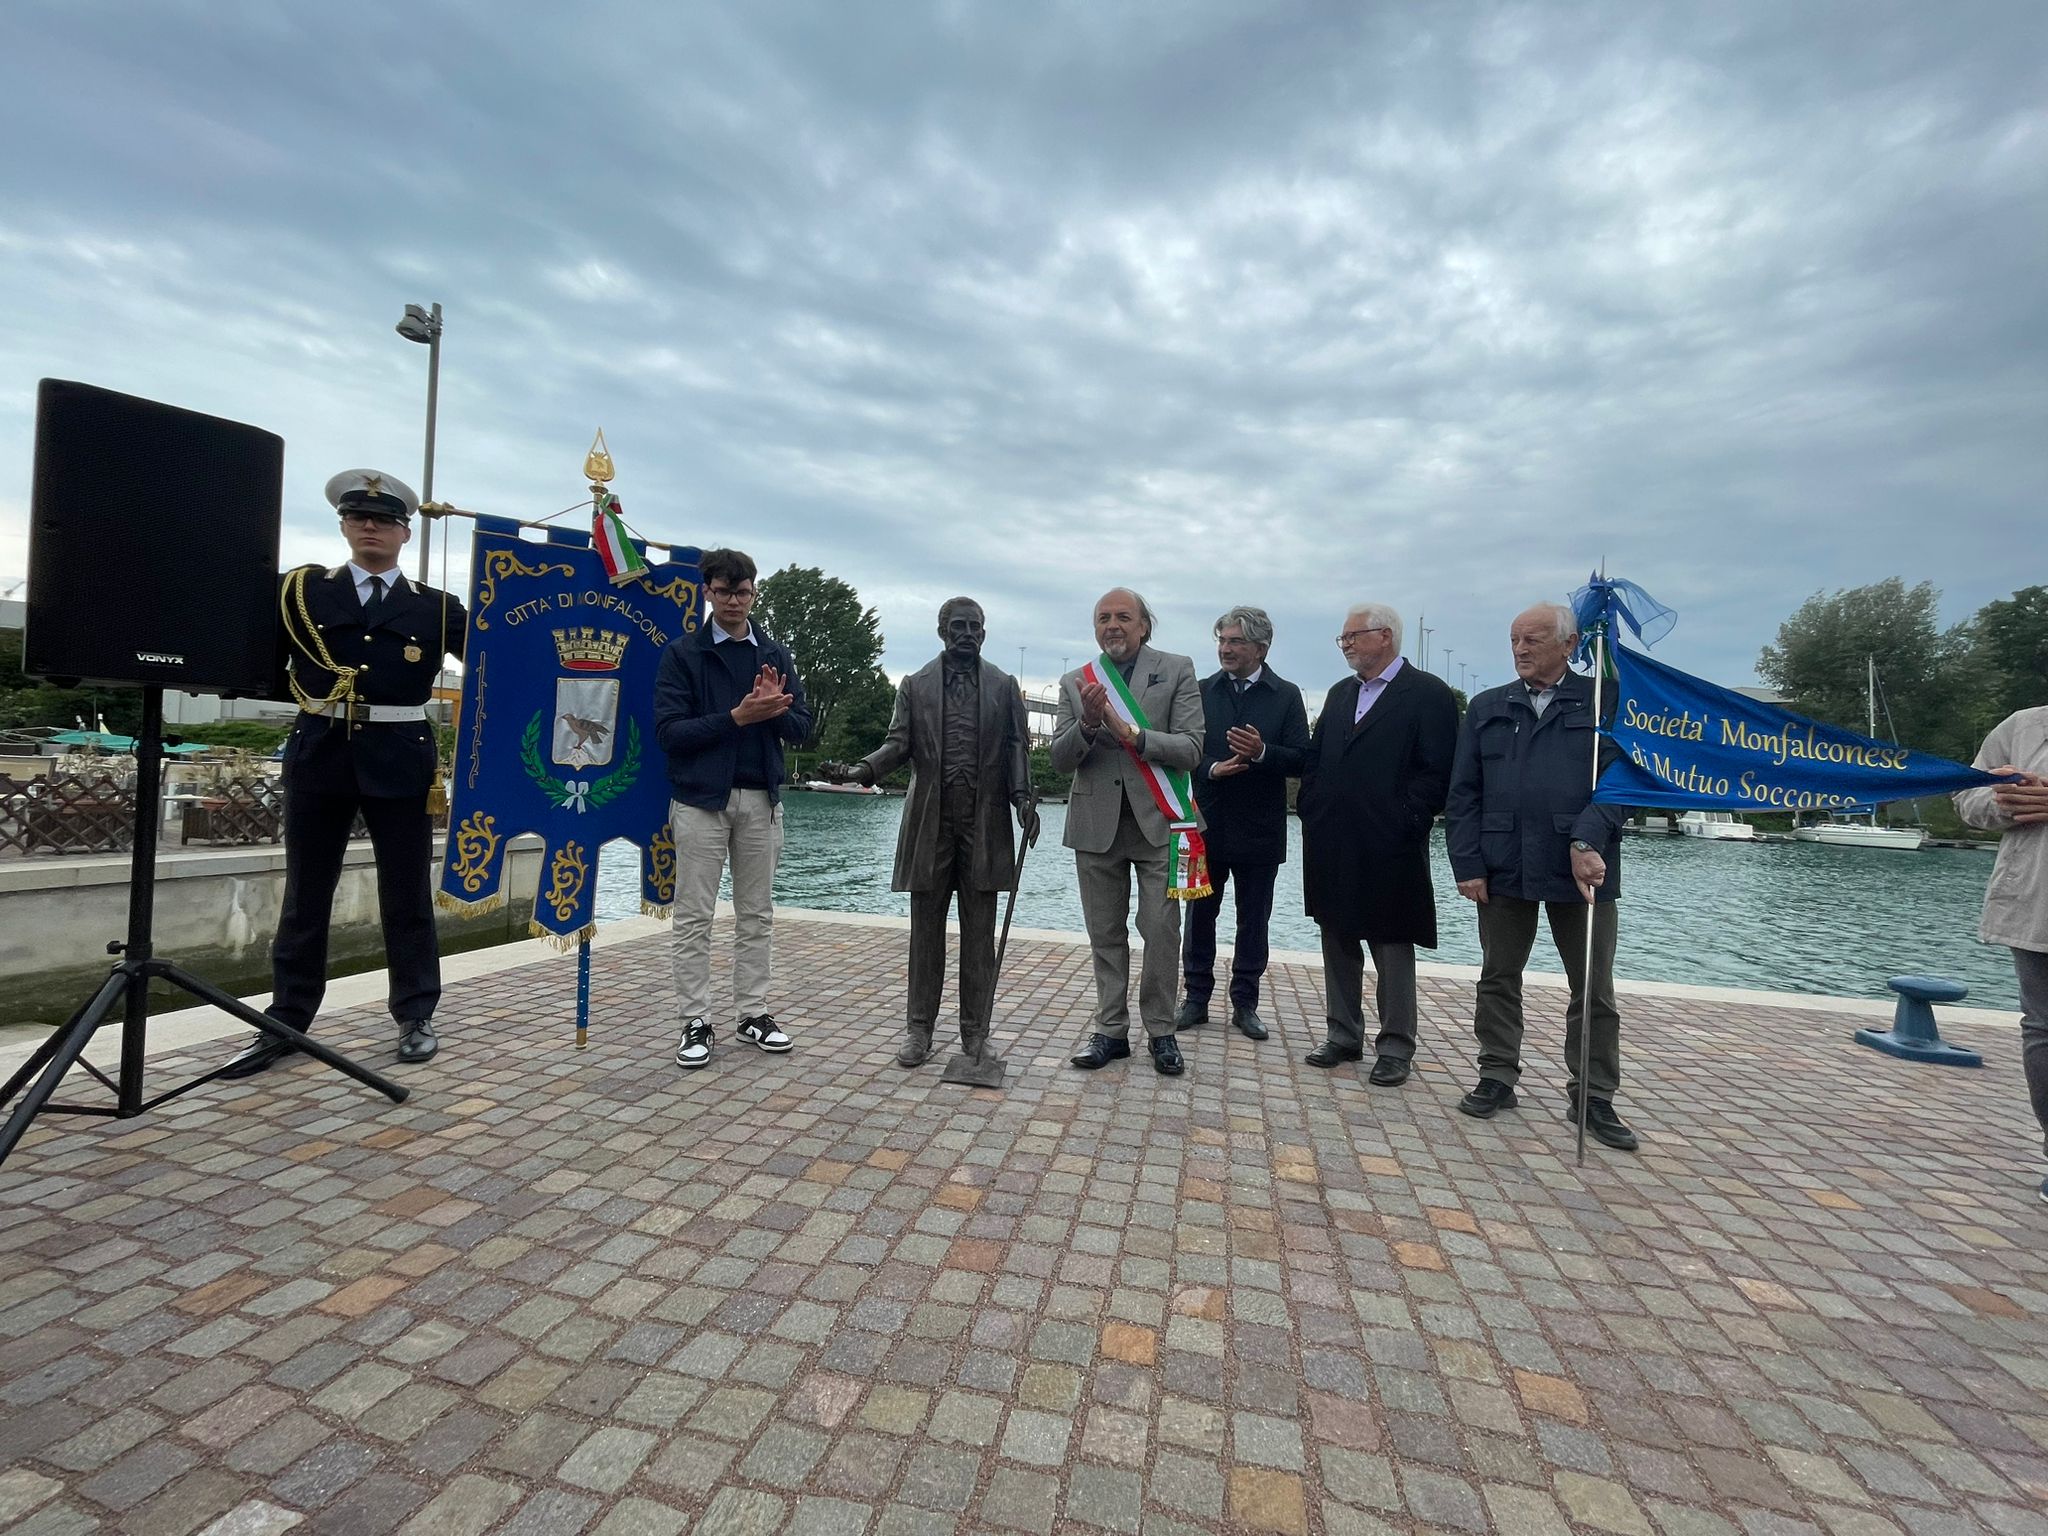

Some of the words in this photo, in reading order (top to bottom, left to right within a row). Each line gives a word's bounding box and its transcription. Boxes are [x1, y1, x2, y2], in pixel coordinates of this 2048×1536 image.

[558, 593, 573, 608] DI
[136, 653, 184, 665] VONYX
[1624, 699, 1709, 742] Societa'
[1721, 718, 1908, 770] Monfalconese
[1632, 742, 1651, 771] di
[1652, 752, 1729, 796] Mutuo
